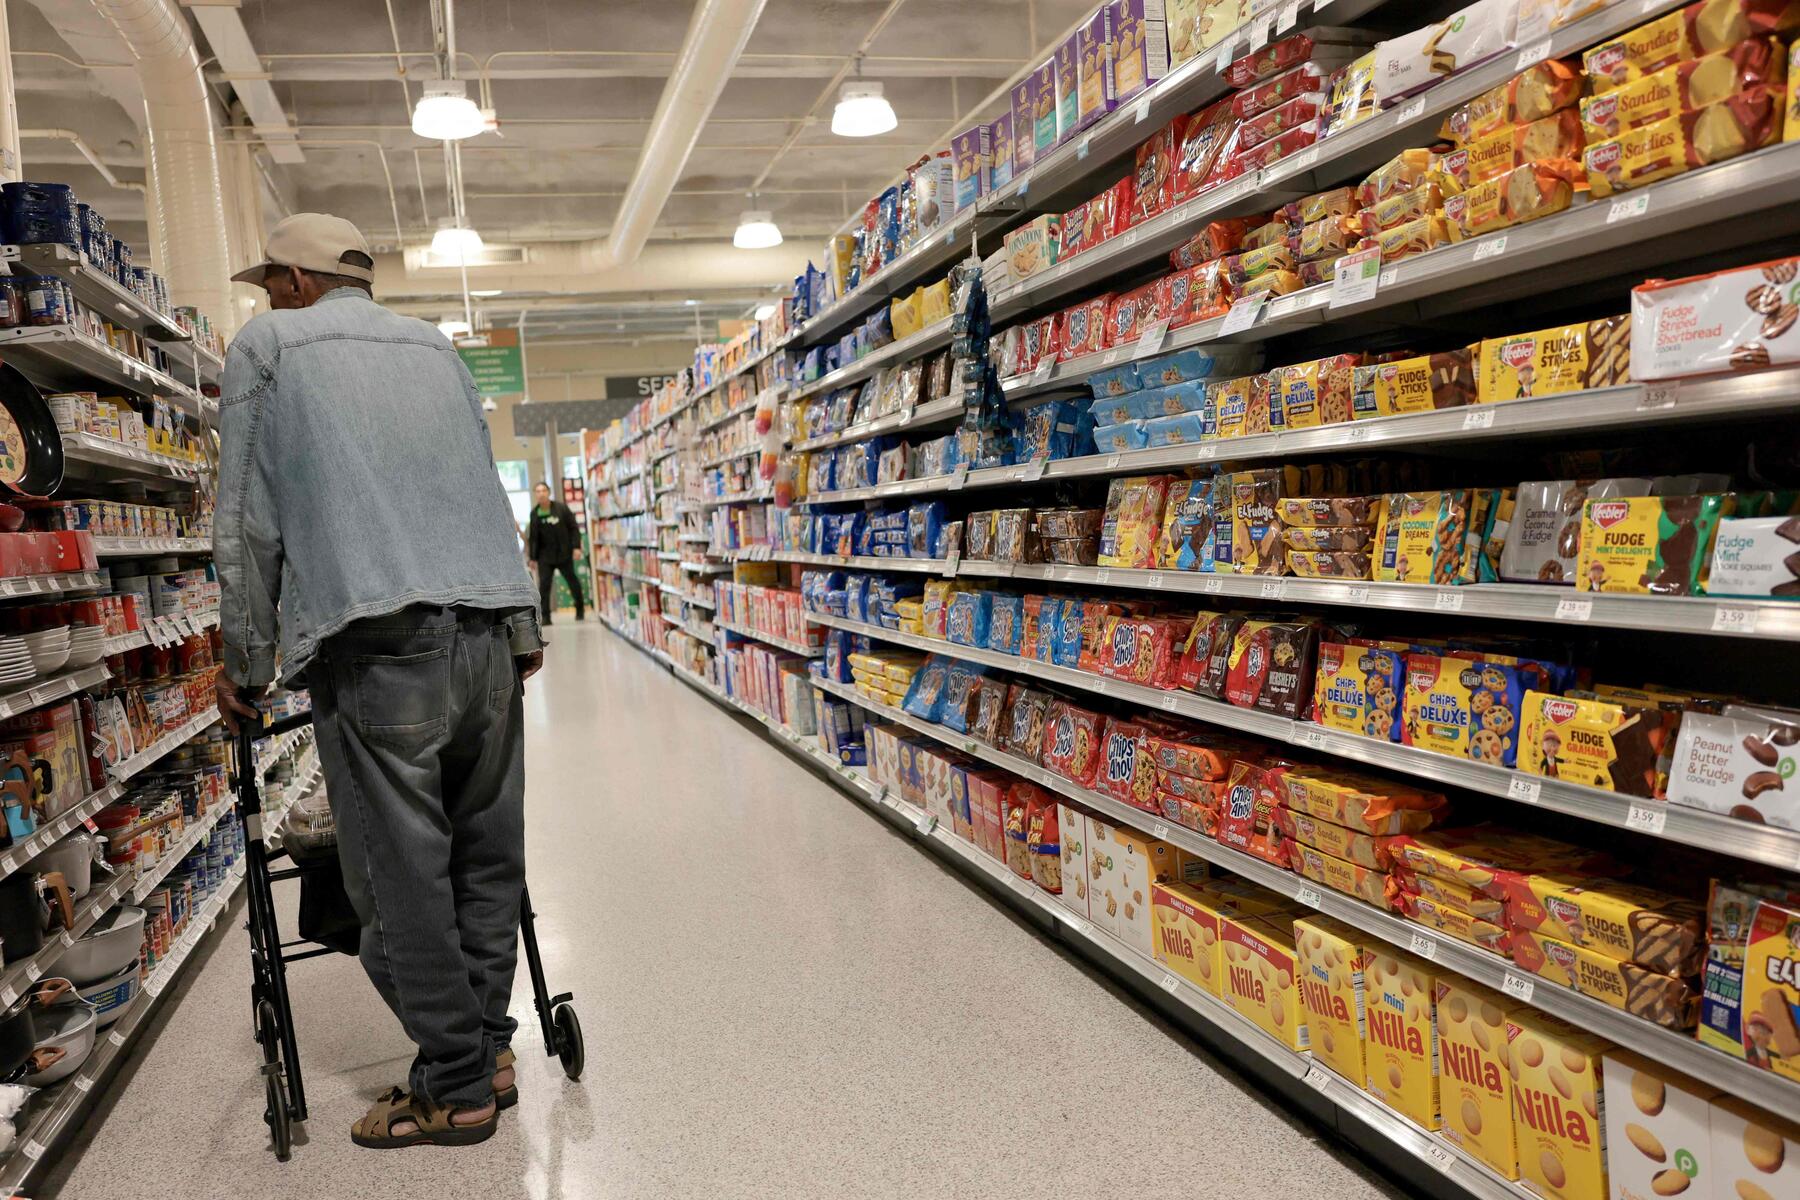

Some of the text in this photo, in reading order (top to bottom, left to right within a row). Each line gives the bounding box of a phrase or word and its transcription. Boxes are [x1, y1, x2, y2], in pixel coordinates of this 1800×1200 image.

[1470, 140, 1511, 165] Sandies
[1662, 304, 1695, 322] Fudge
[1659, 316, 1697, 334] Striped
[1656, 323, 1723, 347] Shortbread
[1541, 349, 1582, 369] STRIPES
[1398, 369, 1428, 385] FUDGE
[1285, 389, 1316, 406] DELUXE
[1400, 380, 1428, 396] STICKS
[1644, 389, 1668, 402] 3.59
[1220, 401, 1246, 417] DELUXE
[1181, 501, 1209, 518] Fudge
[1247, 502, 1275, 520] Fudge
[1592, 503, 1628, 523] Keebler
[1401, 520, 1434, 531] COCONUT
[1524, 518, 1555, 531] Coconut
[1405, 530, 1430, 540] DREAMS
[1521, 530, 1552, 543] & Fudge
[1603, 532, 1646, 546] FUDGE
[1717, 534, 1755, 549] Fudge
[1615, 546, 1653, 556] DELIGHTS
[1715, 549, 1741, 562] Mint
[1264, 582, 1276, 592] 4.39
[1720, 611, 1745, 623] 3.59
[1113, 624, 1134, 649] Chips
[1327, 688, 1364, 707] DELUXE
[1419, 706, 1469, 726] DELUXE
[1544, 699, 1577, 718] Keebler
[1108, 732, 1135, 760] Chips
[1309, 732, 1322, 742] 6.49
[1571, 730, 1605, 748] FUDGE
[1692, 736, 1735, 755] Peanut
[1566, 743, 1609, 760] GRAHAMS
[1689, 748, 1730, 767] Butter
[1685, 774, 1717, 788] COOKIES
[1687, 761, 1736, 785] & Fudge
[1231, 785, 1253, 804] Chips
[1513, 781, 1532, 794] 4.39
[1632, 809, 1654, 822] 3.59
[1170, 896, 1195, 916] FAMILY SIZE
[1548, 898, 1580, 921] Keebler
[1585, 914, 1627, 938] FUDGE
[1160, 926, 1194, 960] Nilla
[1241, 933, 1269, 956] FAMILY SIZE
[1414, 937, 1430, 948] 5.65
[1586, 927, 1630, 951] STRIPES
[1547, 943, 1577, 964] Keebler
[1311, 962, 1329, 983] mini
[1580, 960, 1621, 985] FUDGE
[1229, 964, 1266, 1004] Nilla
[1507, 975, 1526, 991] 6.49
[1580, 973, 1624, 998] STRIPES
[1707, 978, 1719, 993] TO
[1719, 982, 1740, 1001] WIN
[1302, 977, 1351, 1022] Nilla
[1384, 991, 1405, 1013] mini
[1367, 1006, 1425, 1057] Nilla
[1440, 1037, 1504, 1094] Nilla
[1514, 1082, 1591, 1146] Nilla
[1429, 1147, 1448, 1162] 4.79
